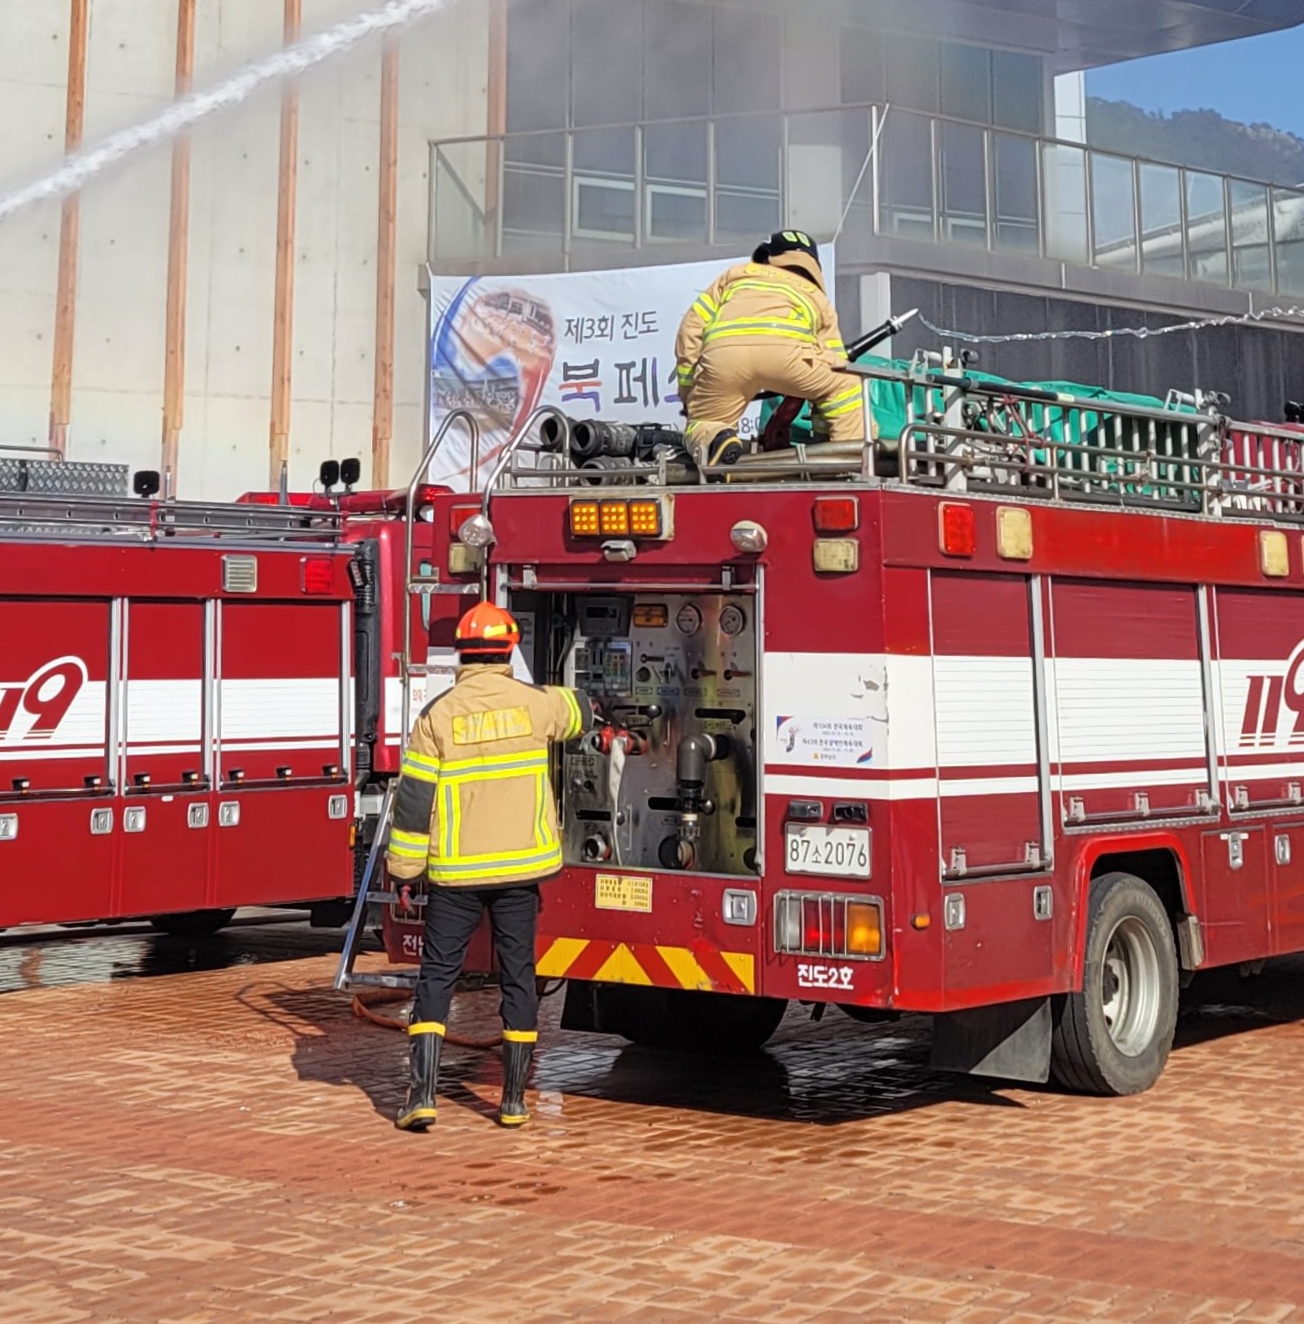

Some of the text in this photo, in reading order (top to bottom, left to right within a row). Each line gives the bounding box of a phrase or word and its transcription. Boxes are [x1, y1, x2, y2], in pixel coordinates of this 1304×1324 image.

[564, 310, 659, 344] 제3회 진도
[558, 357, 602, 413] 북
[790, 838, 867, 867] 87소2076
[797, 963, 854, 990] 진도2호
